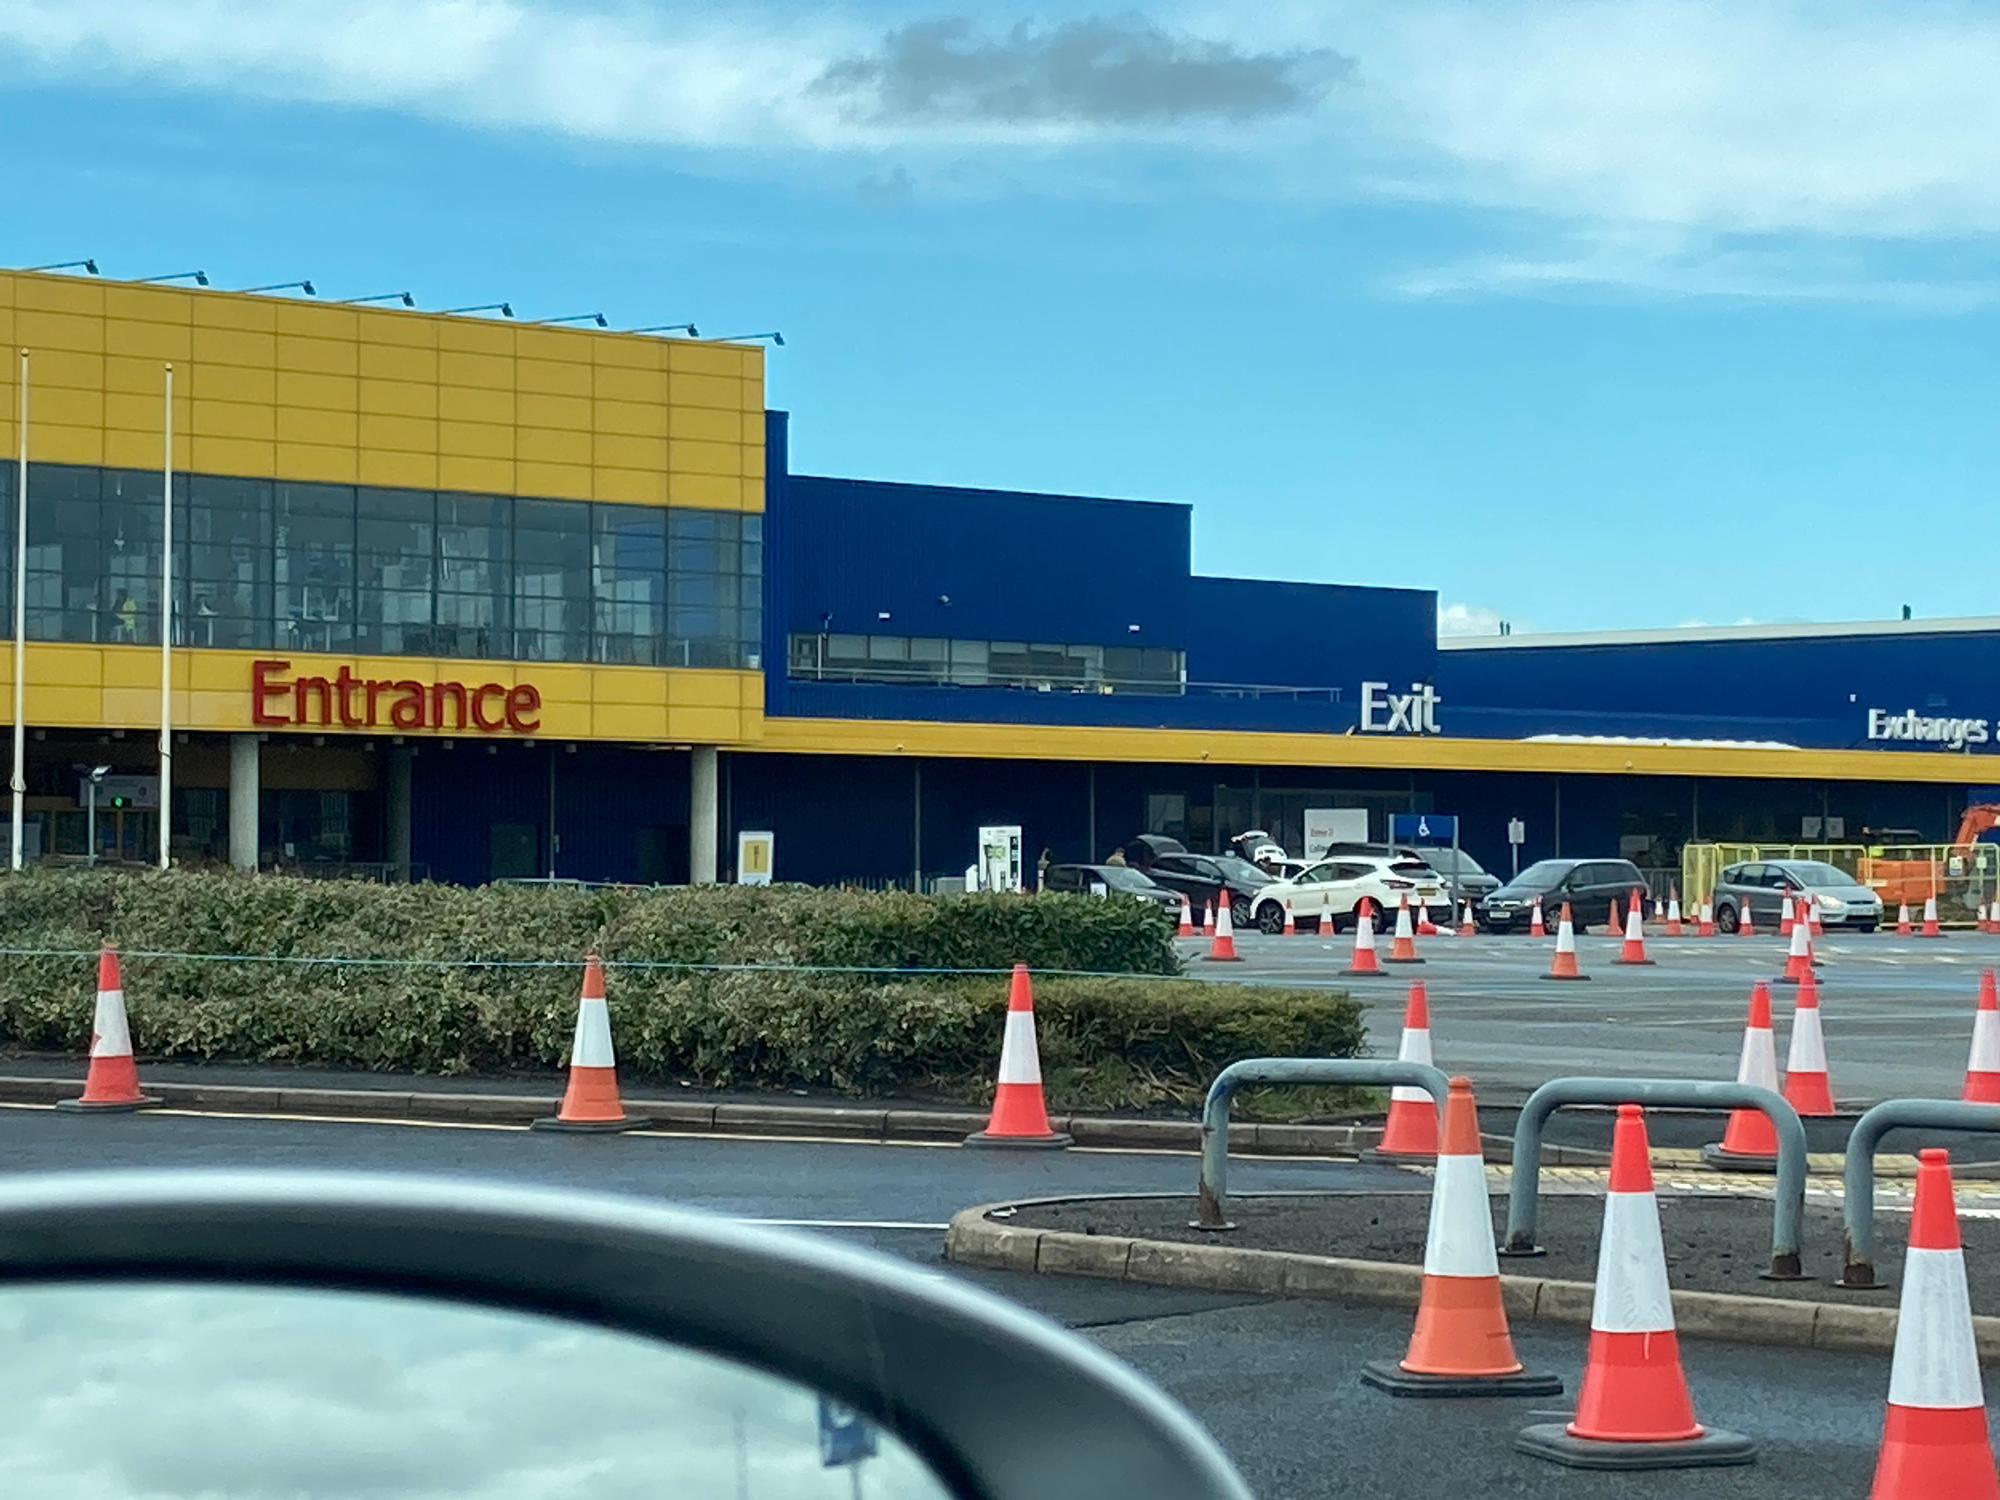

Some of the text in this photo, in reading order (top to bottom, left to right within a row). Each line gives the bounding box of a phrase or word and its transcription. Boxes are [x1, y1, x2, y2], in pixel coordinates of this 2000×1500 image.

[252, 660, 541, 733] Entrance
[1361, 681, 1441, 733] Exit
[1868, 708, 1989, 749] Exchanges
